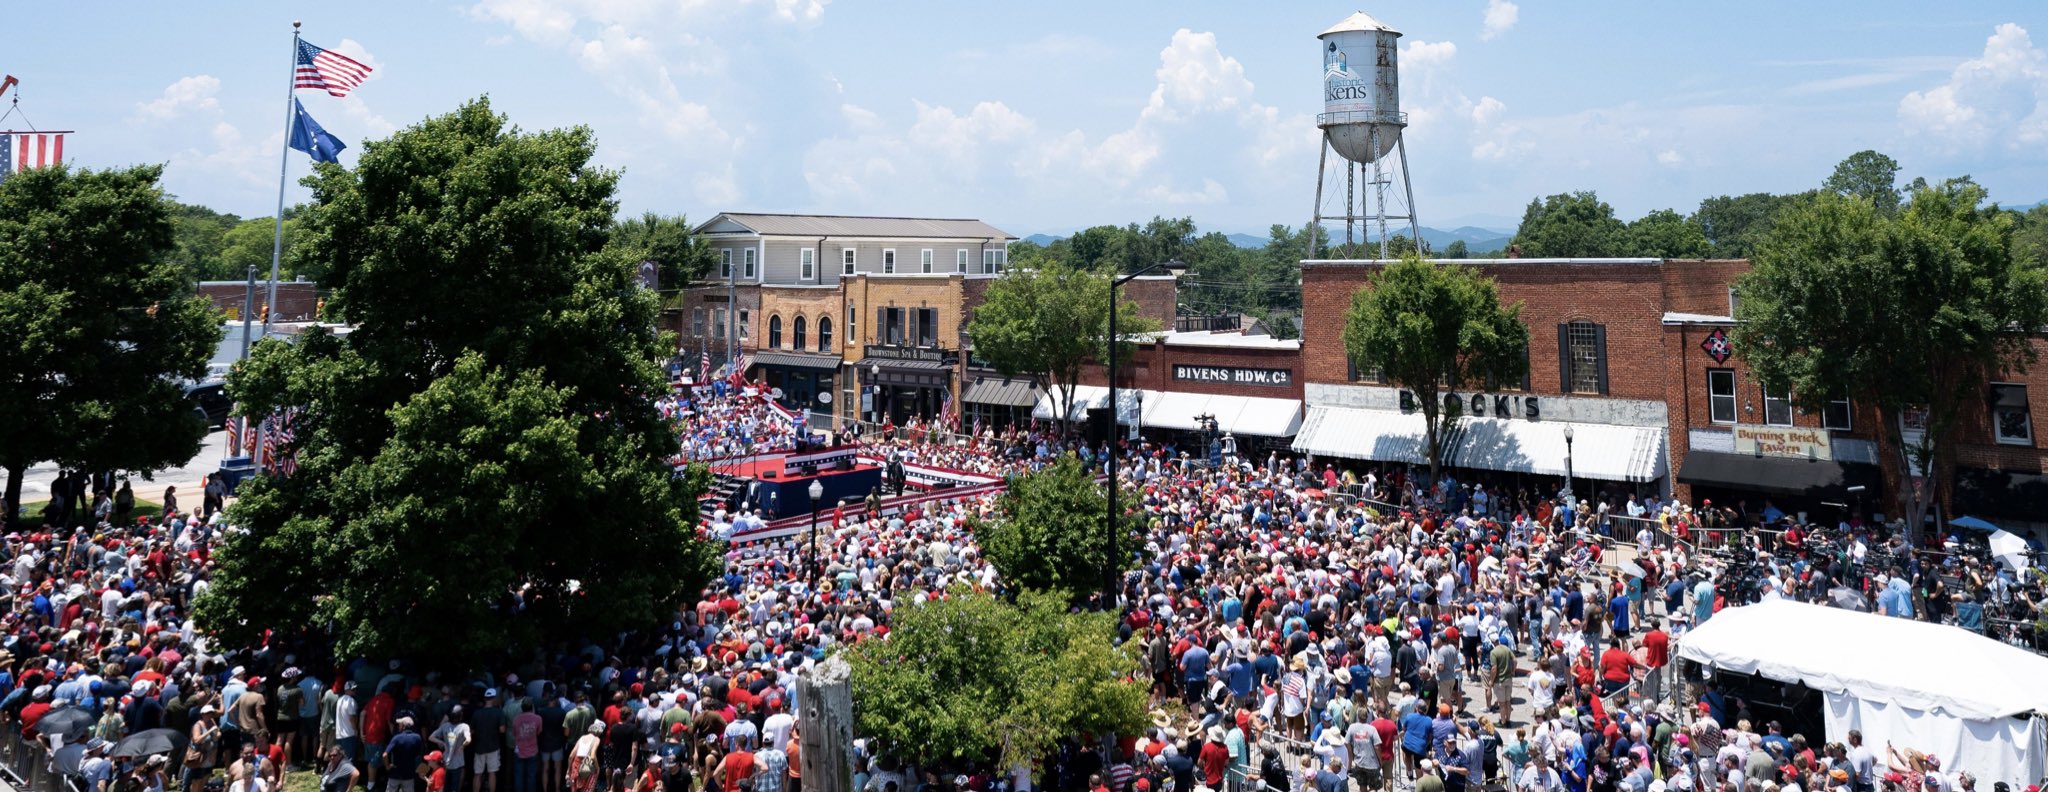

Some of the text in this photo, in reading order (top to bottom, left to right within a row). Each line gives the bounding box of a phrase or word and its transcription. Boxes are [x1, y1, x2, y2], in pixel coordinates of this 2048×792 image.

[912, 350, 918, 359] &
[920, 351, 942, 361] BOUTIQ
[1177, 367, 1229, 381] BIVENS
[1235, 369, 1270, 383] HDW.
[1399, 390, 1540, 417] BOCK'S
[1738, 429, 1828, 447] Burning Brick
[1757, 442, 1800, 454] Tavern
